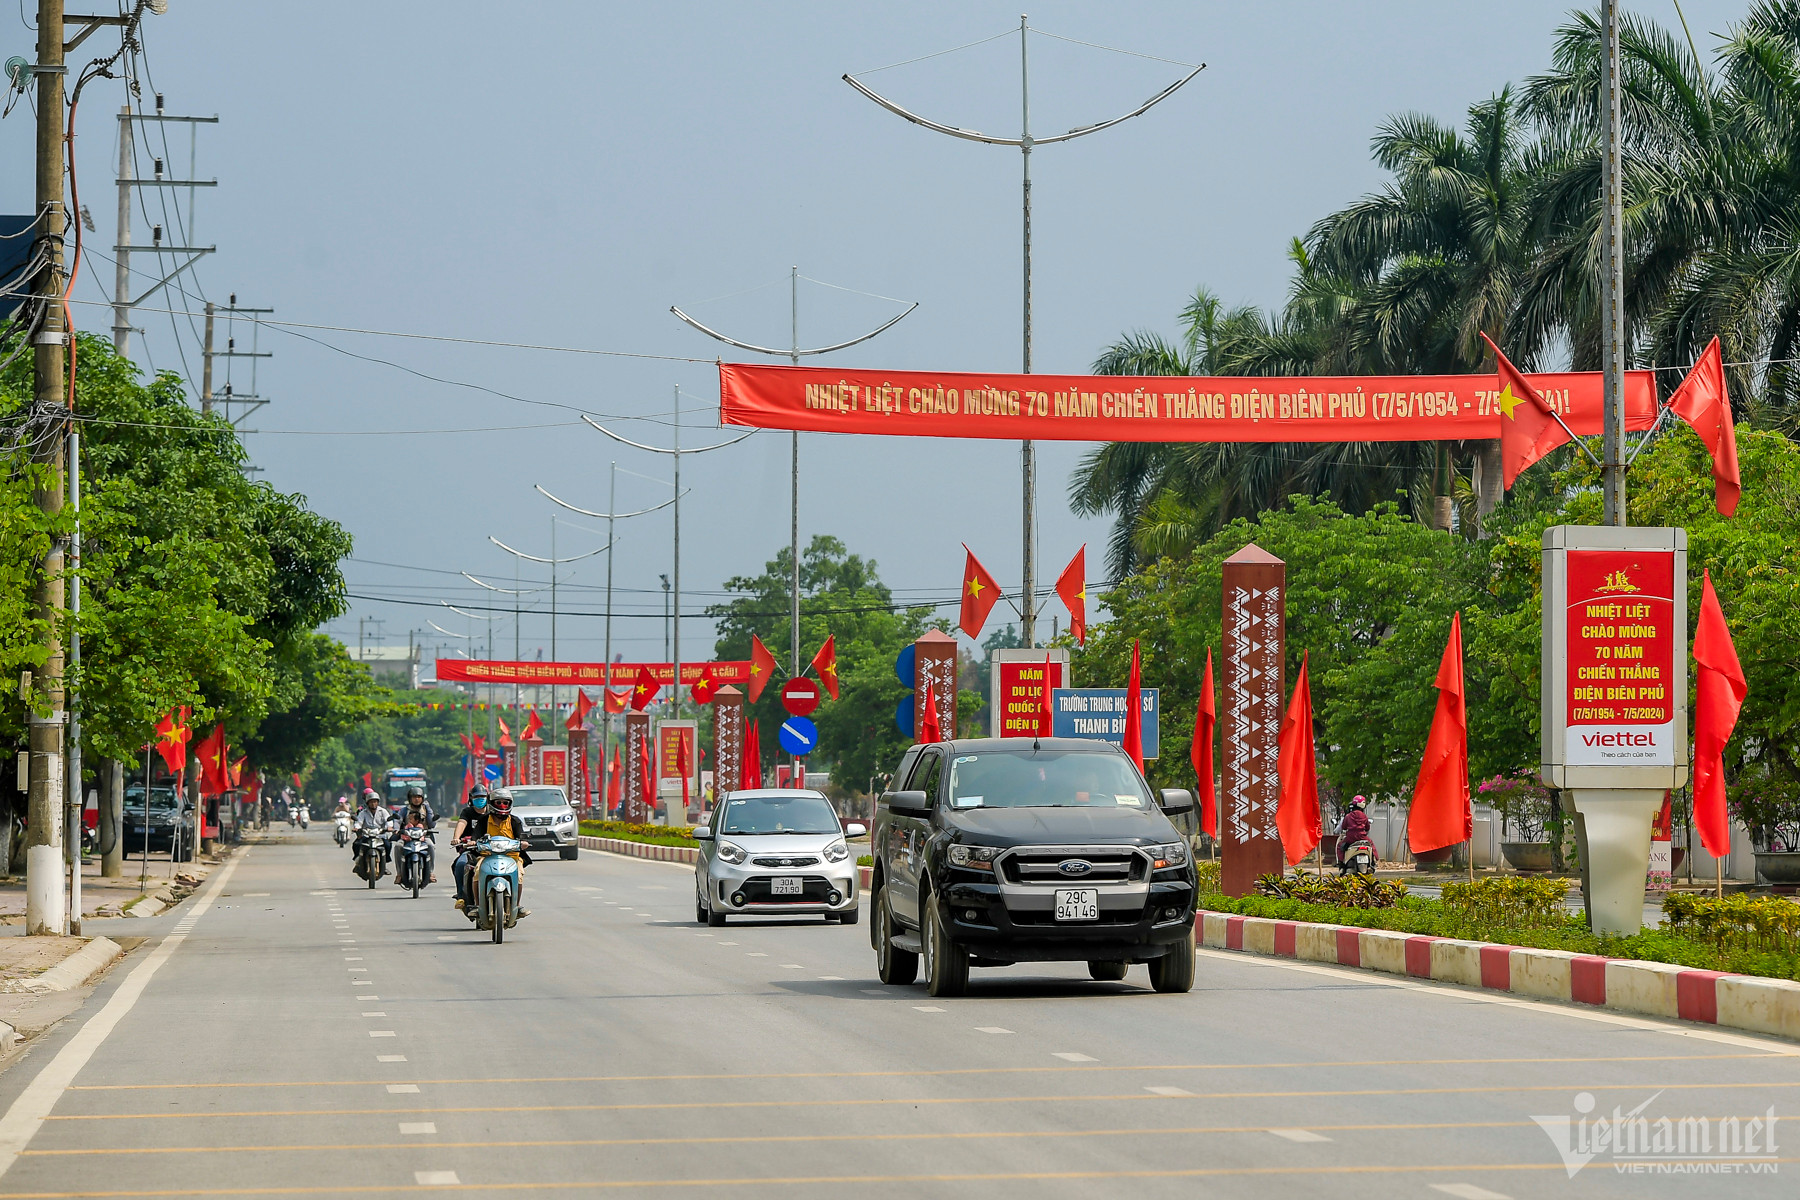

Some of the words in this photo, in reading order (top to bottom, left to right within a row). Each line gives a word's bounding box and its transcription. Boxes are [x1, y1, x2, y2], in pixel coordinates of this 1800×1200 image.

[805, 380, 860, 414] NHIỆT
[866, 382, 903, 416] LIỆT
[909, 384, 958, 414] CHÀO
[964, 384, 1020, 416] MỪNG
[1026, 392, 1048, 416] 70
[1054, 386, 1098, 417] NĂM
[1102, 387, 1158, 418] CHIẾN
[1163, 387, 1225, 419] THẮNG
[1230, 388, 1274, 422] ĐIỆN
[1279, 388, 1323, 418] BIÊN
[1328, 386, 1365, 418] PHỦ
[1372, 392, 1458, 420] (7/5/1954
[1586, 603, 1622, 620] NHIỆT
[1626, 603, 1650, 620] LIỆT
[1582, 623, 1615, 638] CHÀO
[1619, 623, 1656, 638] MỪNG
[1595, 647, 1610, 658] 70
[1614, 644, 1643, 658] NĂM
[557, 666, 572, 677] PHỦ
[601, 668, 614, 678] LY
[616, 667, 633, 678] NĂM
[1020, 668, 1043, 680] NĂM
[1578, 663, 1615, 679] CHIẾN
[1619, 662, 1660, 679] THẮNG
[1012, 686, 1025, 697] DU
[1574, 685, 1603, 702] ĐIỆN
[1607, 685, 1636, 700] BIÊN
[1640, 683, 1664, 700] PHỦ
[1008, 699, 1034, 714] QUỐC
[1060, 694, 1088, 712] TRƯỜNG
[1090, 697, 1113, 712] TRUNG
[1143, 691, 1153, 712] SỞ
[1573, 708, 1615, 720] (7/5/1954
[1623, 708, 1664, 720] 7/5/2024)
[1006, 717, 1030, 732] ĐIỆN
[1074, 719, 1108, 733] THANH
[1582, 732, 1656, 746] viettel
[1066, 863, 1084, 871] Ford
[1066, 892, 1087, 904] 29C
